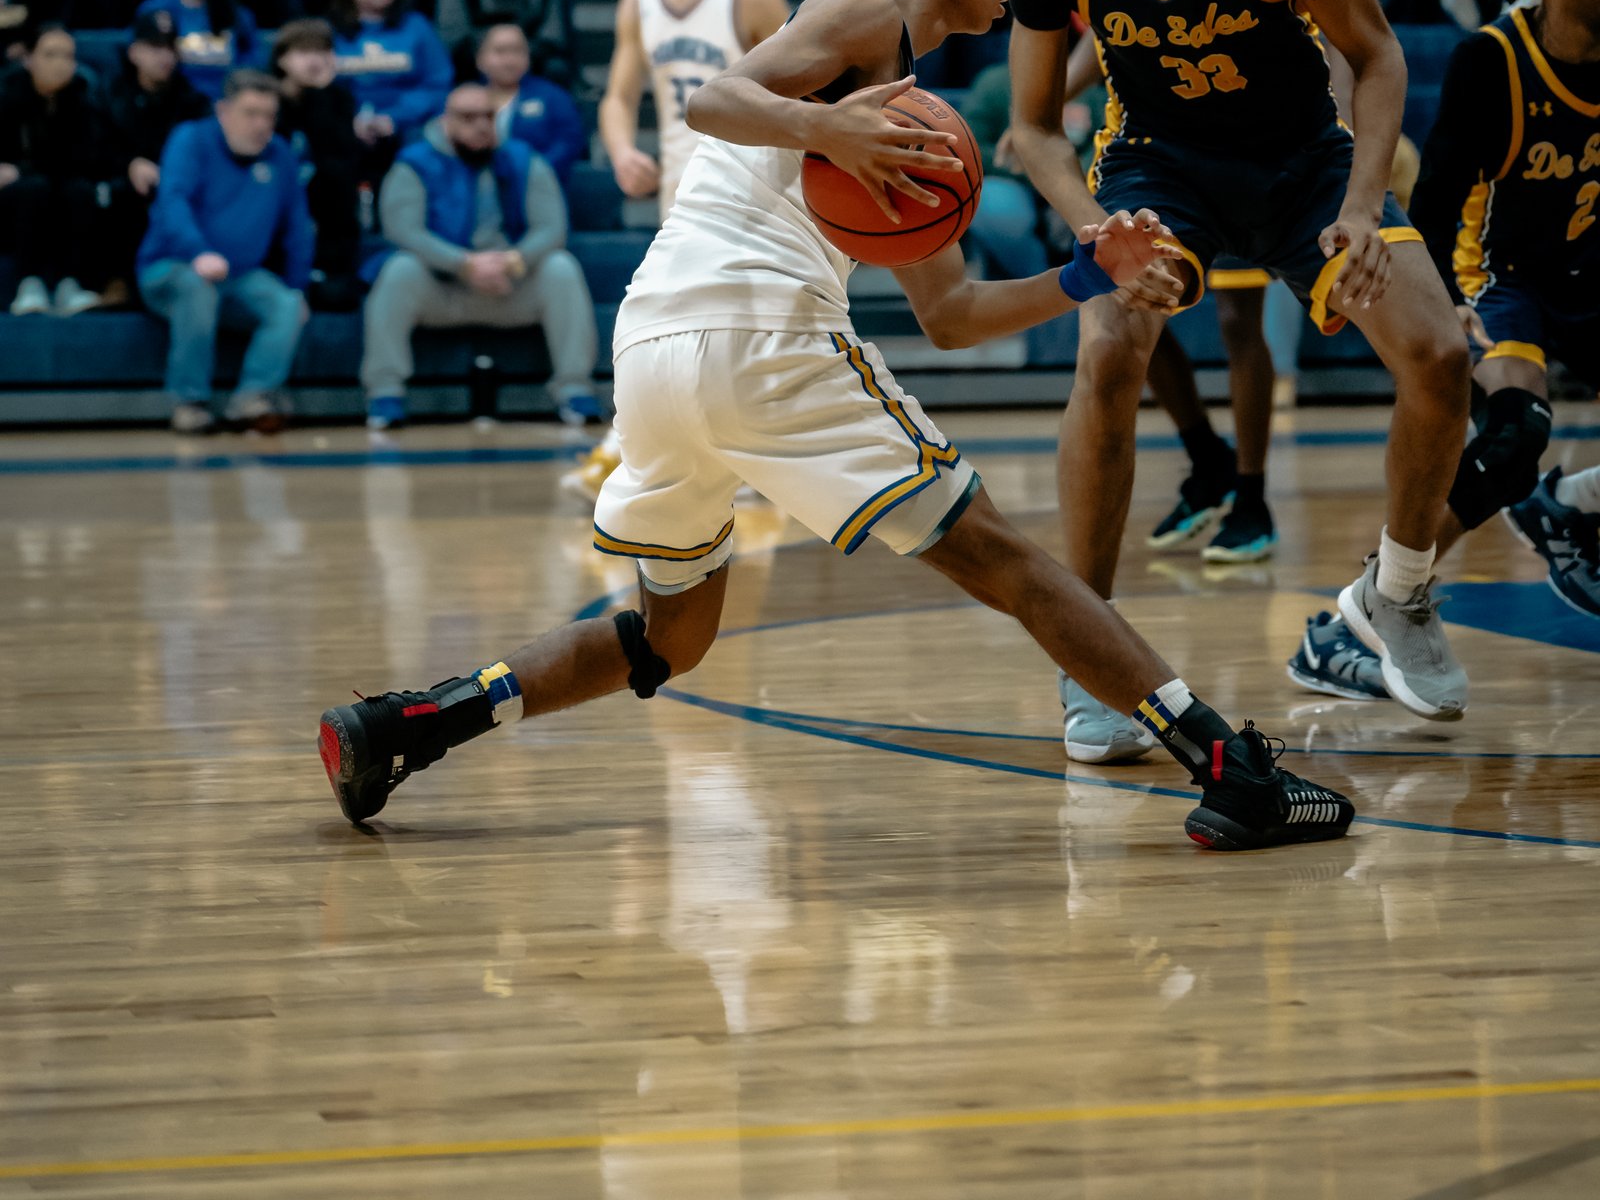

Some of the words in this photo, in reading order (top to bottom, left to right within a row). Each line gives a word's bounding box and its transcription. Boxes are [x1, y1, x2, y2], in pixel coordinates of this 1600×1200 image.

[1103, 11, 1160, 48] De
[1166, 2, 1259, 49] Sales
[1522, 141, 1575, 180] De
